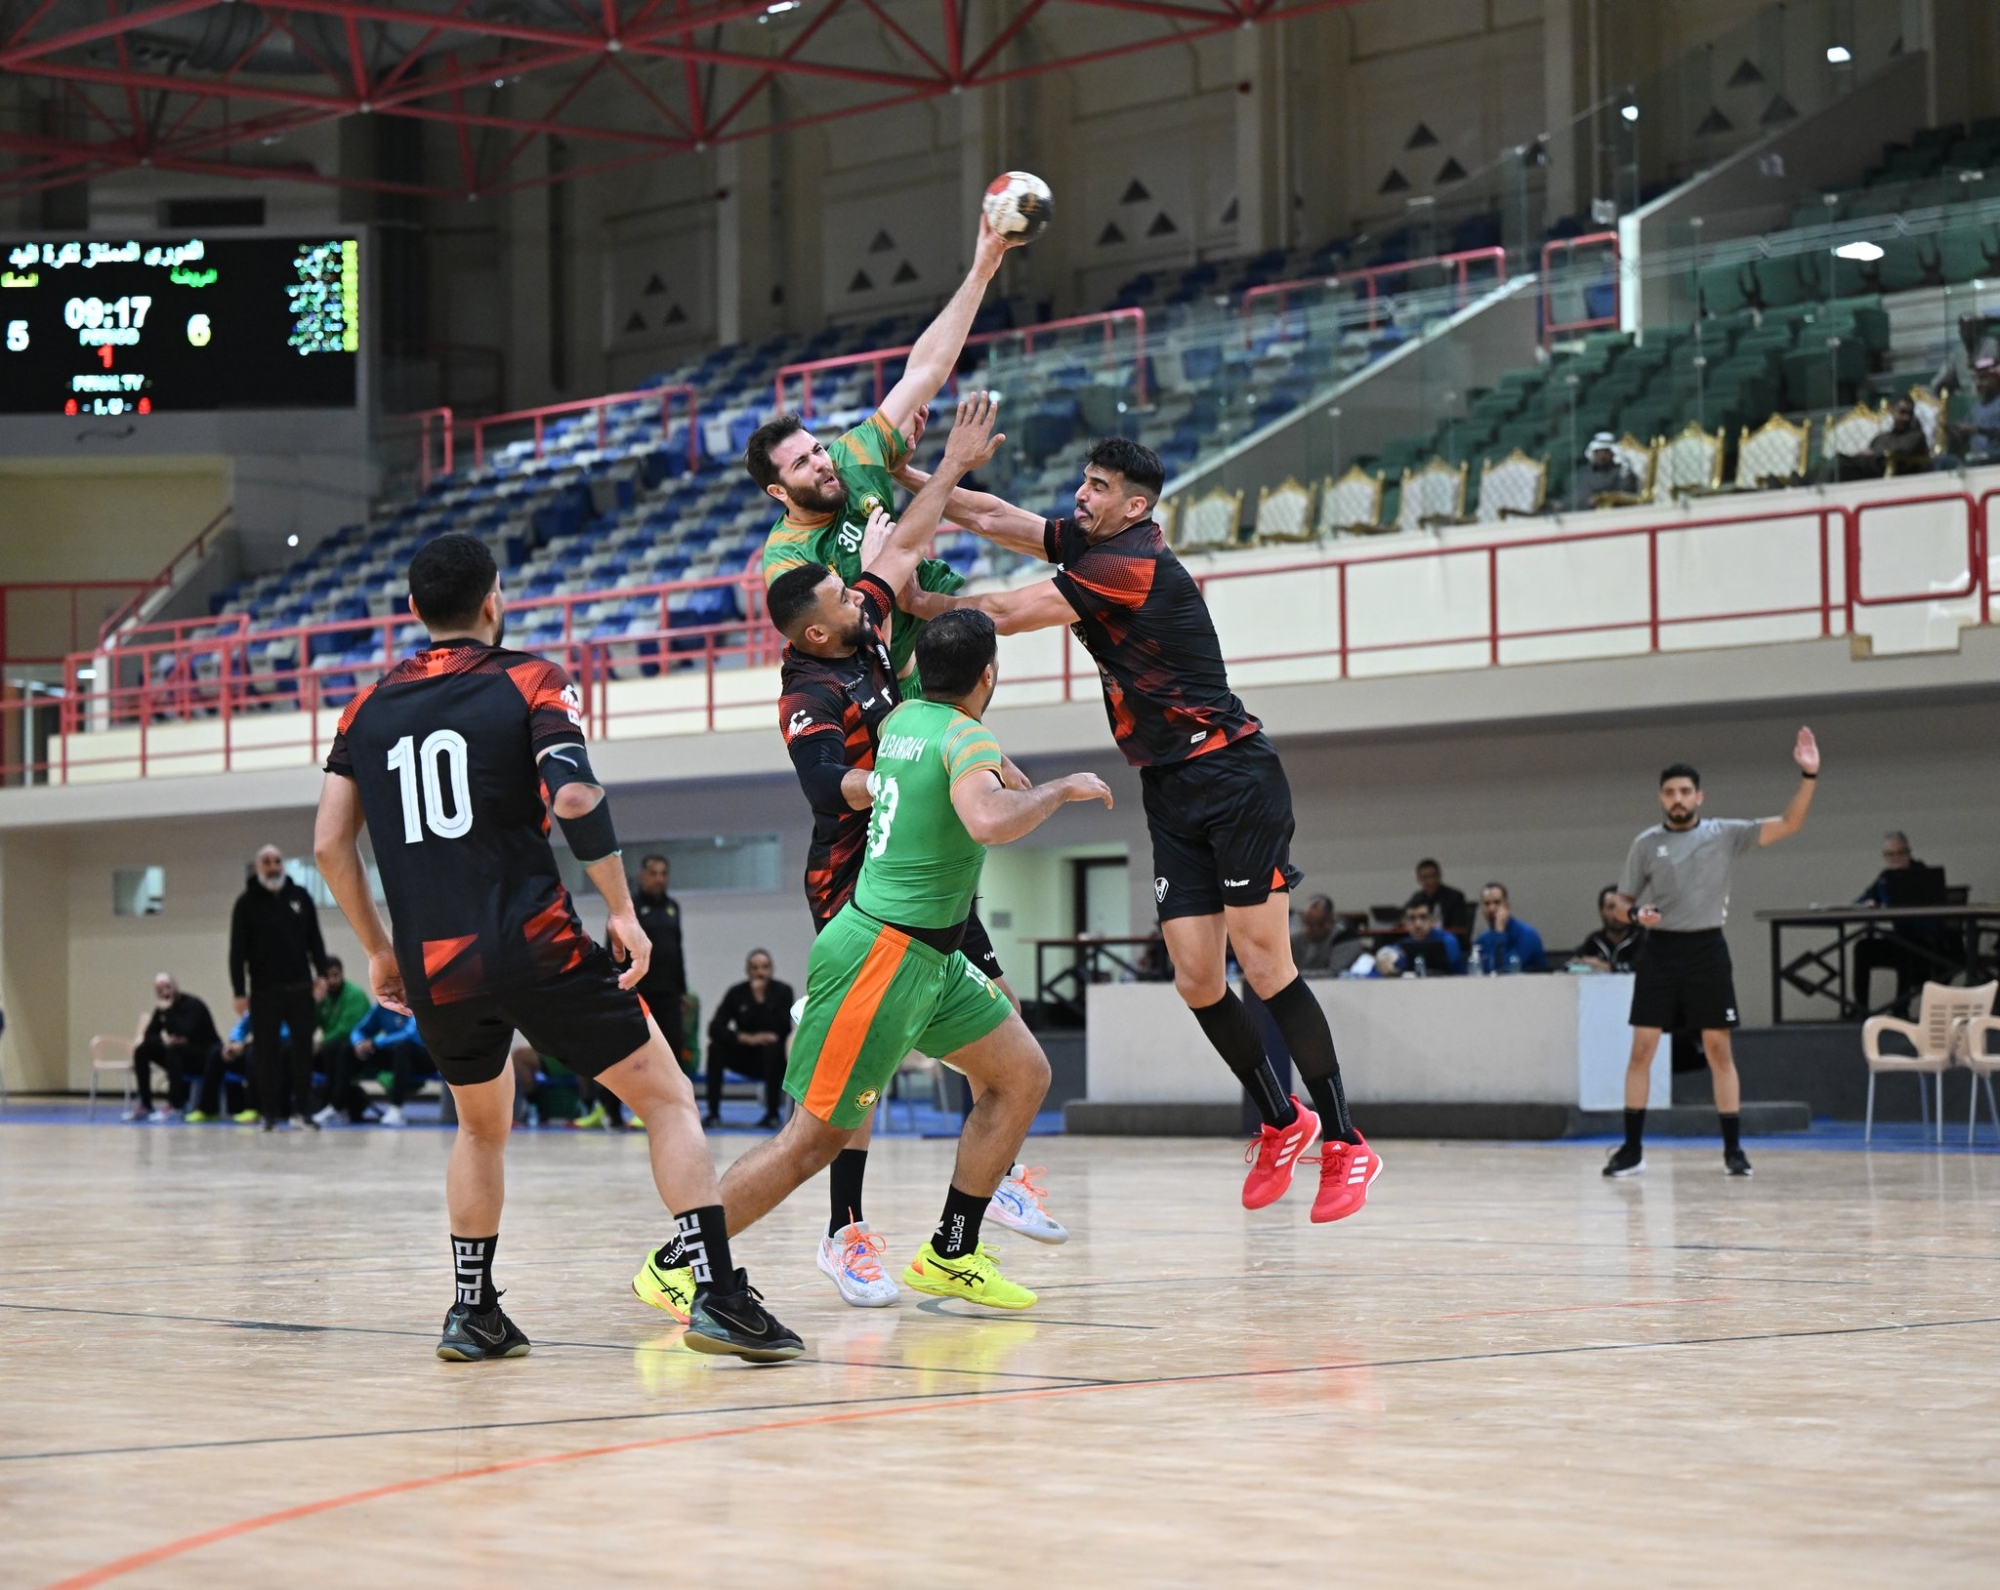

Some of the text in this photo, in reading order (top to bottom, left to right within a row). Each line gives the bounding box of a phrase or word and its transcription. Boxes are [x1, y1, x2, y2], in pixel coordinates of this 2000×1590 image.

[64, 296, 152, 330] 09:17
[187, 313, 212, 347] 6
[6, 319, 30, 352] 5
[97, 343, 114, 369] 1
[838, 520, 863, 553] 30
[387, 729, 474, 844] 10
[946, 1213, 966, 1253] SPORTS
